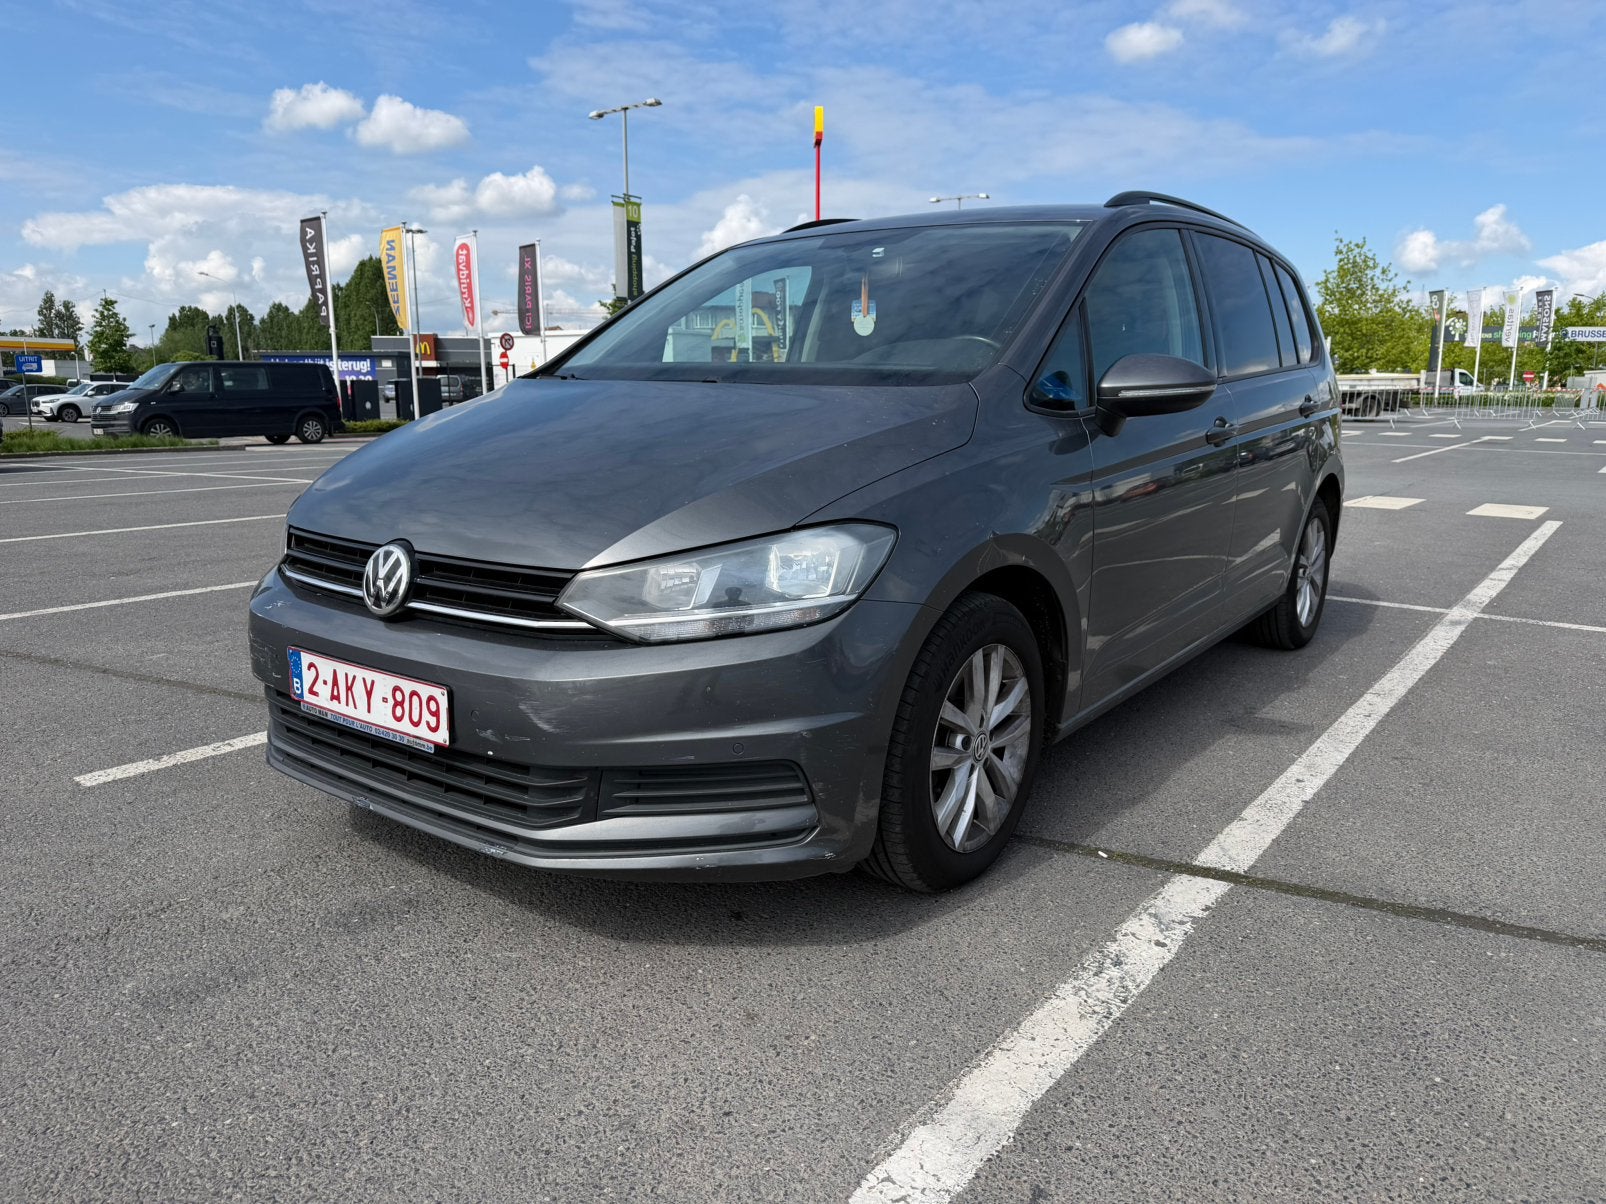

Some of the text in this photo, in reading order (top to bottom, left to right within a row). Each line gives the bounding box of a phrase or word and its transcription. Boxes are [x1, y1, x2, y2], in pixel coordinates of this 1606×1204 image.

[628, 205, 639, 218] 10
[338, 358, 371, 373] terug!
[293, 677, 302, 694] B
[307, 661, 441, 733] 2-AKY-809
